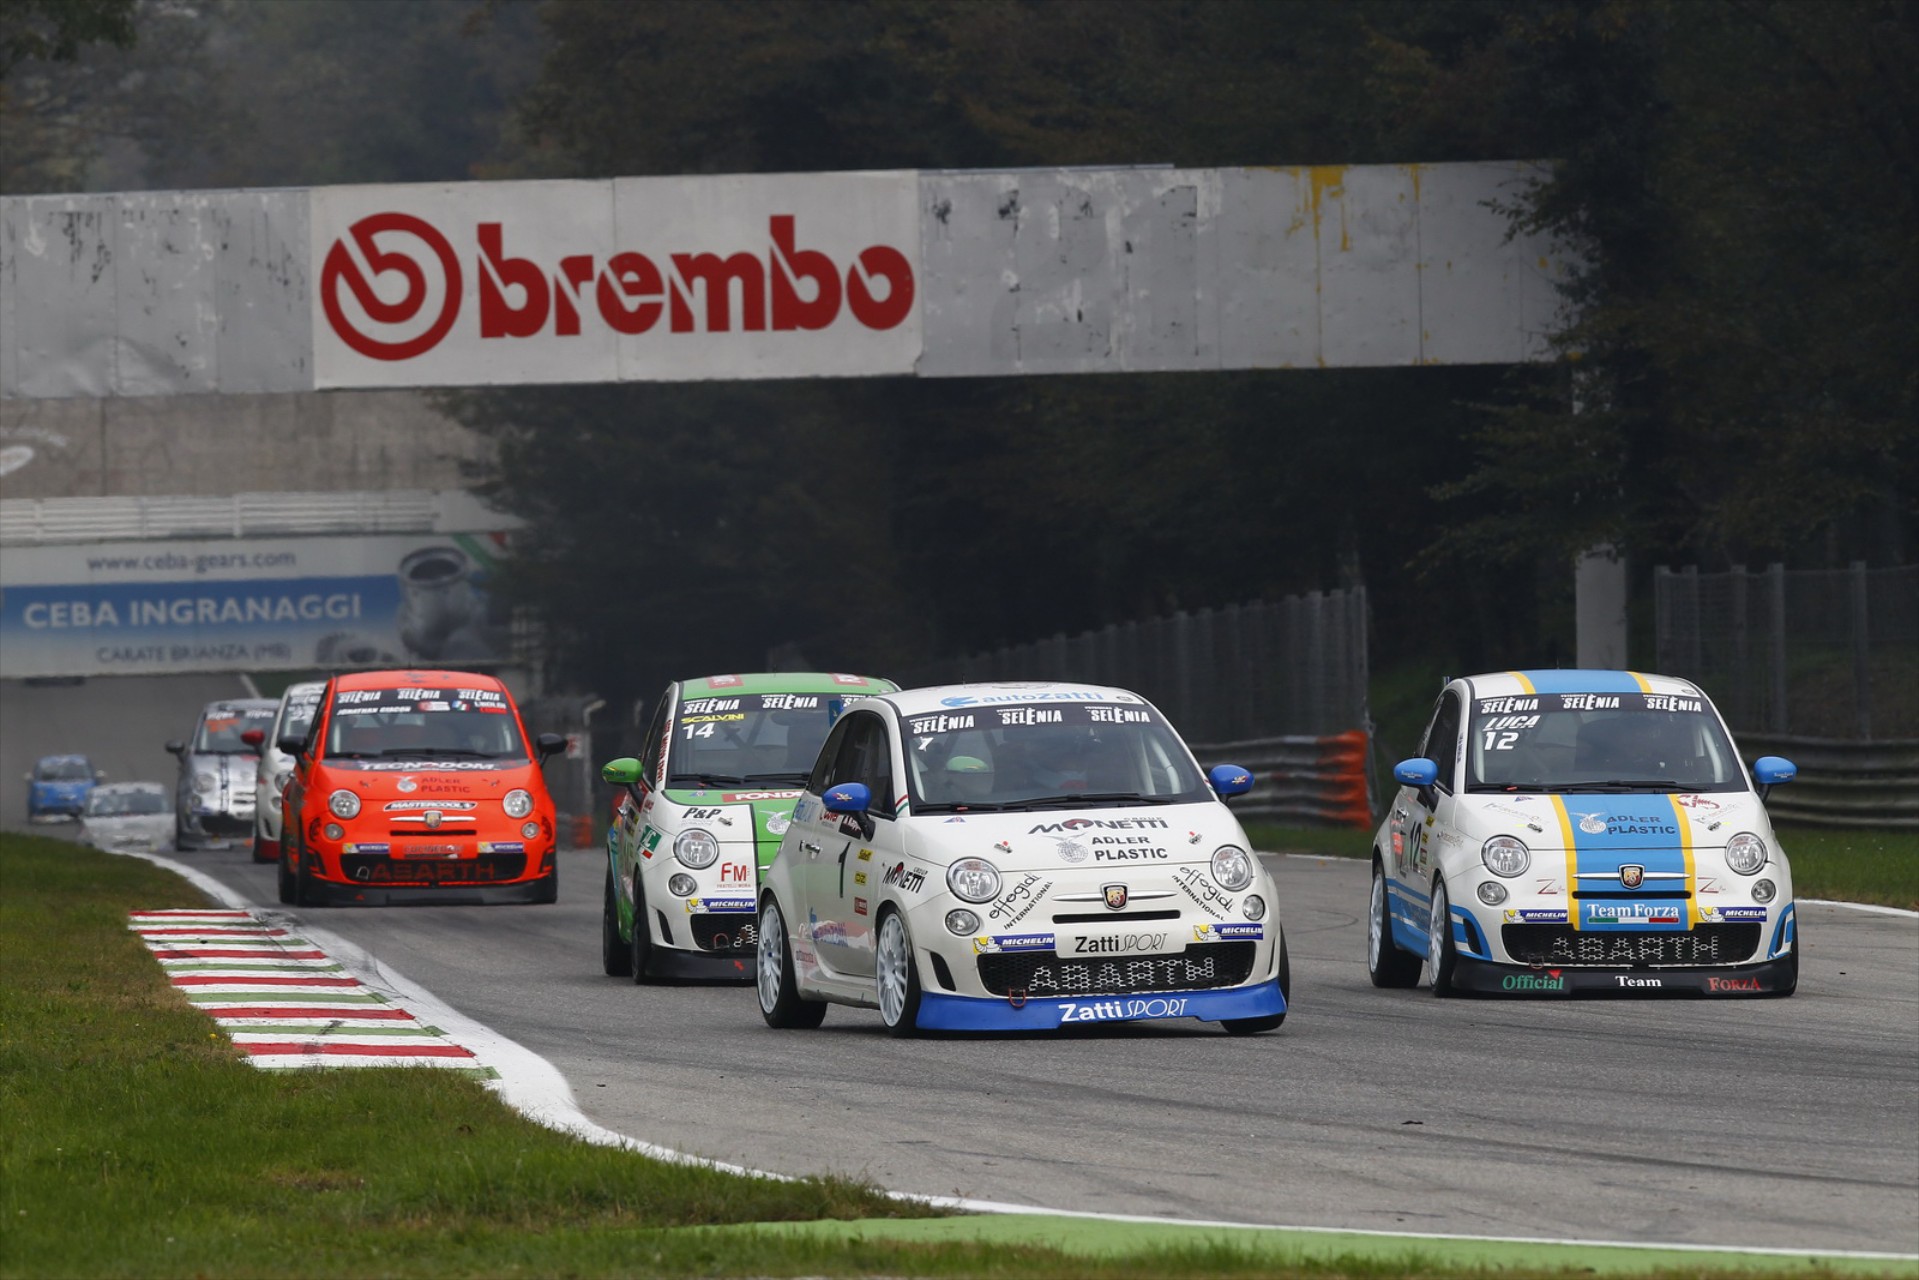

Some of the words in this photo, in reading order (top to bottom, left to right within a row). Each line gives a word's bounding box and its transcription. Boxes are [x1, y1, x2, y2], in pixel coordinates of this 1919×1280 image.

[476, 214, 916, 338] brembo
[87, 550, 297, 574] www.ceba-gears.com
[23, 600, 120, 630] CEBA
[129, 594, 362, 626] INGRANAGGI
[96, 645, 165, 664] CARATE
[170, 644, 250, 663] BRIANZA
[763, 694, 818, 709] SELENIA
[983, 691, 1104, 703] autozatti
[1563, 694, 1620, 710] SELENIA
[1646, 696, 1702, 712] SELENIA
[685, 698, 740, 715] SELENIA
[1481, 697, 1539, 714] SELENIA
[681, 713, 745, 724] SCALVINI
[1002, 707, 1063, 725] SELENIA
[1090, 707, 1151, 723] SELENIA
[1482, 715, 1541, 731] LUCA
[682, 722, 715, 740] 14
[913, 715, 975, 734] SELENIA
[1484, 731, 1519, 751] 12
[421, 785, 471, 793] PLASTIC
[682, 807, 722, 819] P&P
[1606, 815, 1661, 823] ADLER
[1028, 818, 1169, 834] MONETTI
[1607, 826, 1676, 835] PLASTIC
[1092, 836, 1151, 845] ADLER
[1094, 848, 1168, 861] PLASTIC
[371, 863, 495, 881] ABARTH
[720, 862, 747, 882] FM
[838, 841, 851, 898] 1
[883, 861, 926, 894] MONETTI
[709, 900, 755, 908] MICHELIN
[1003, 880, 1054, 930] INTERNATIONAL
[1172, 875, 1225, 922] INTERNATIONAL
[1525, 911, 1568, 919] MICHELIN
[1587, 904, 1633, 918] Team
[1634, 904, 1679, 918] Forza
[1725, 909, 1767, 917] MICHELIN
[1220, 926, 1263, 935] MICHELIN
[1001, 936, 1054, 946] MICHELIN
[1553, 935, 1719, 961] ABARTH
[1029, 957, 1215, 992] ABARTH
[1502, 974, 1565, 991] Official
[1615, 975, 1662, 987] Team
